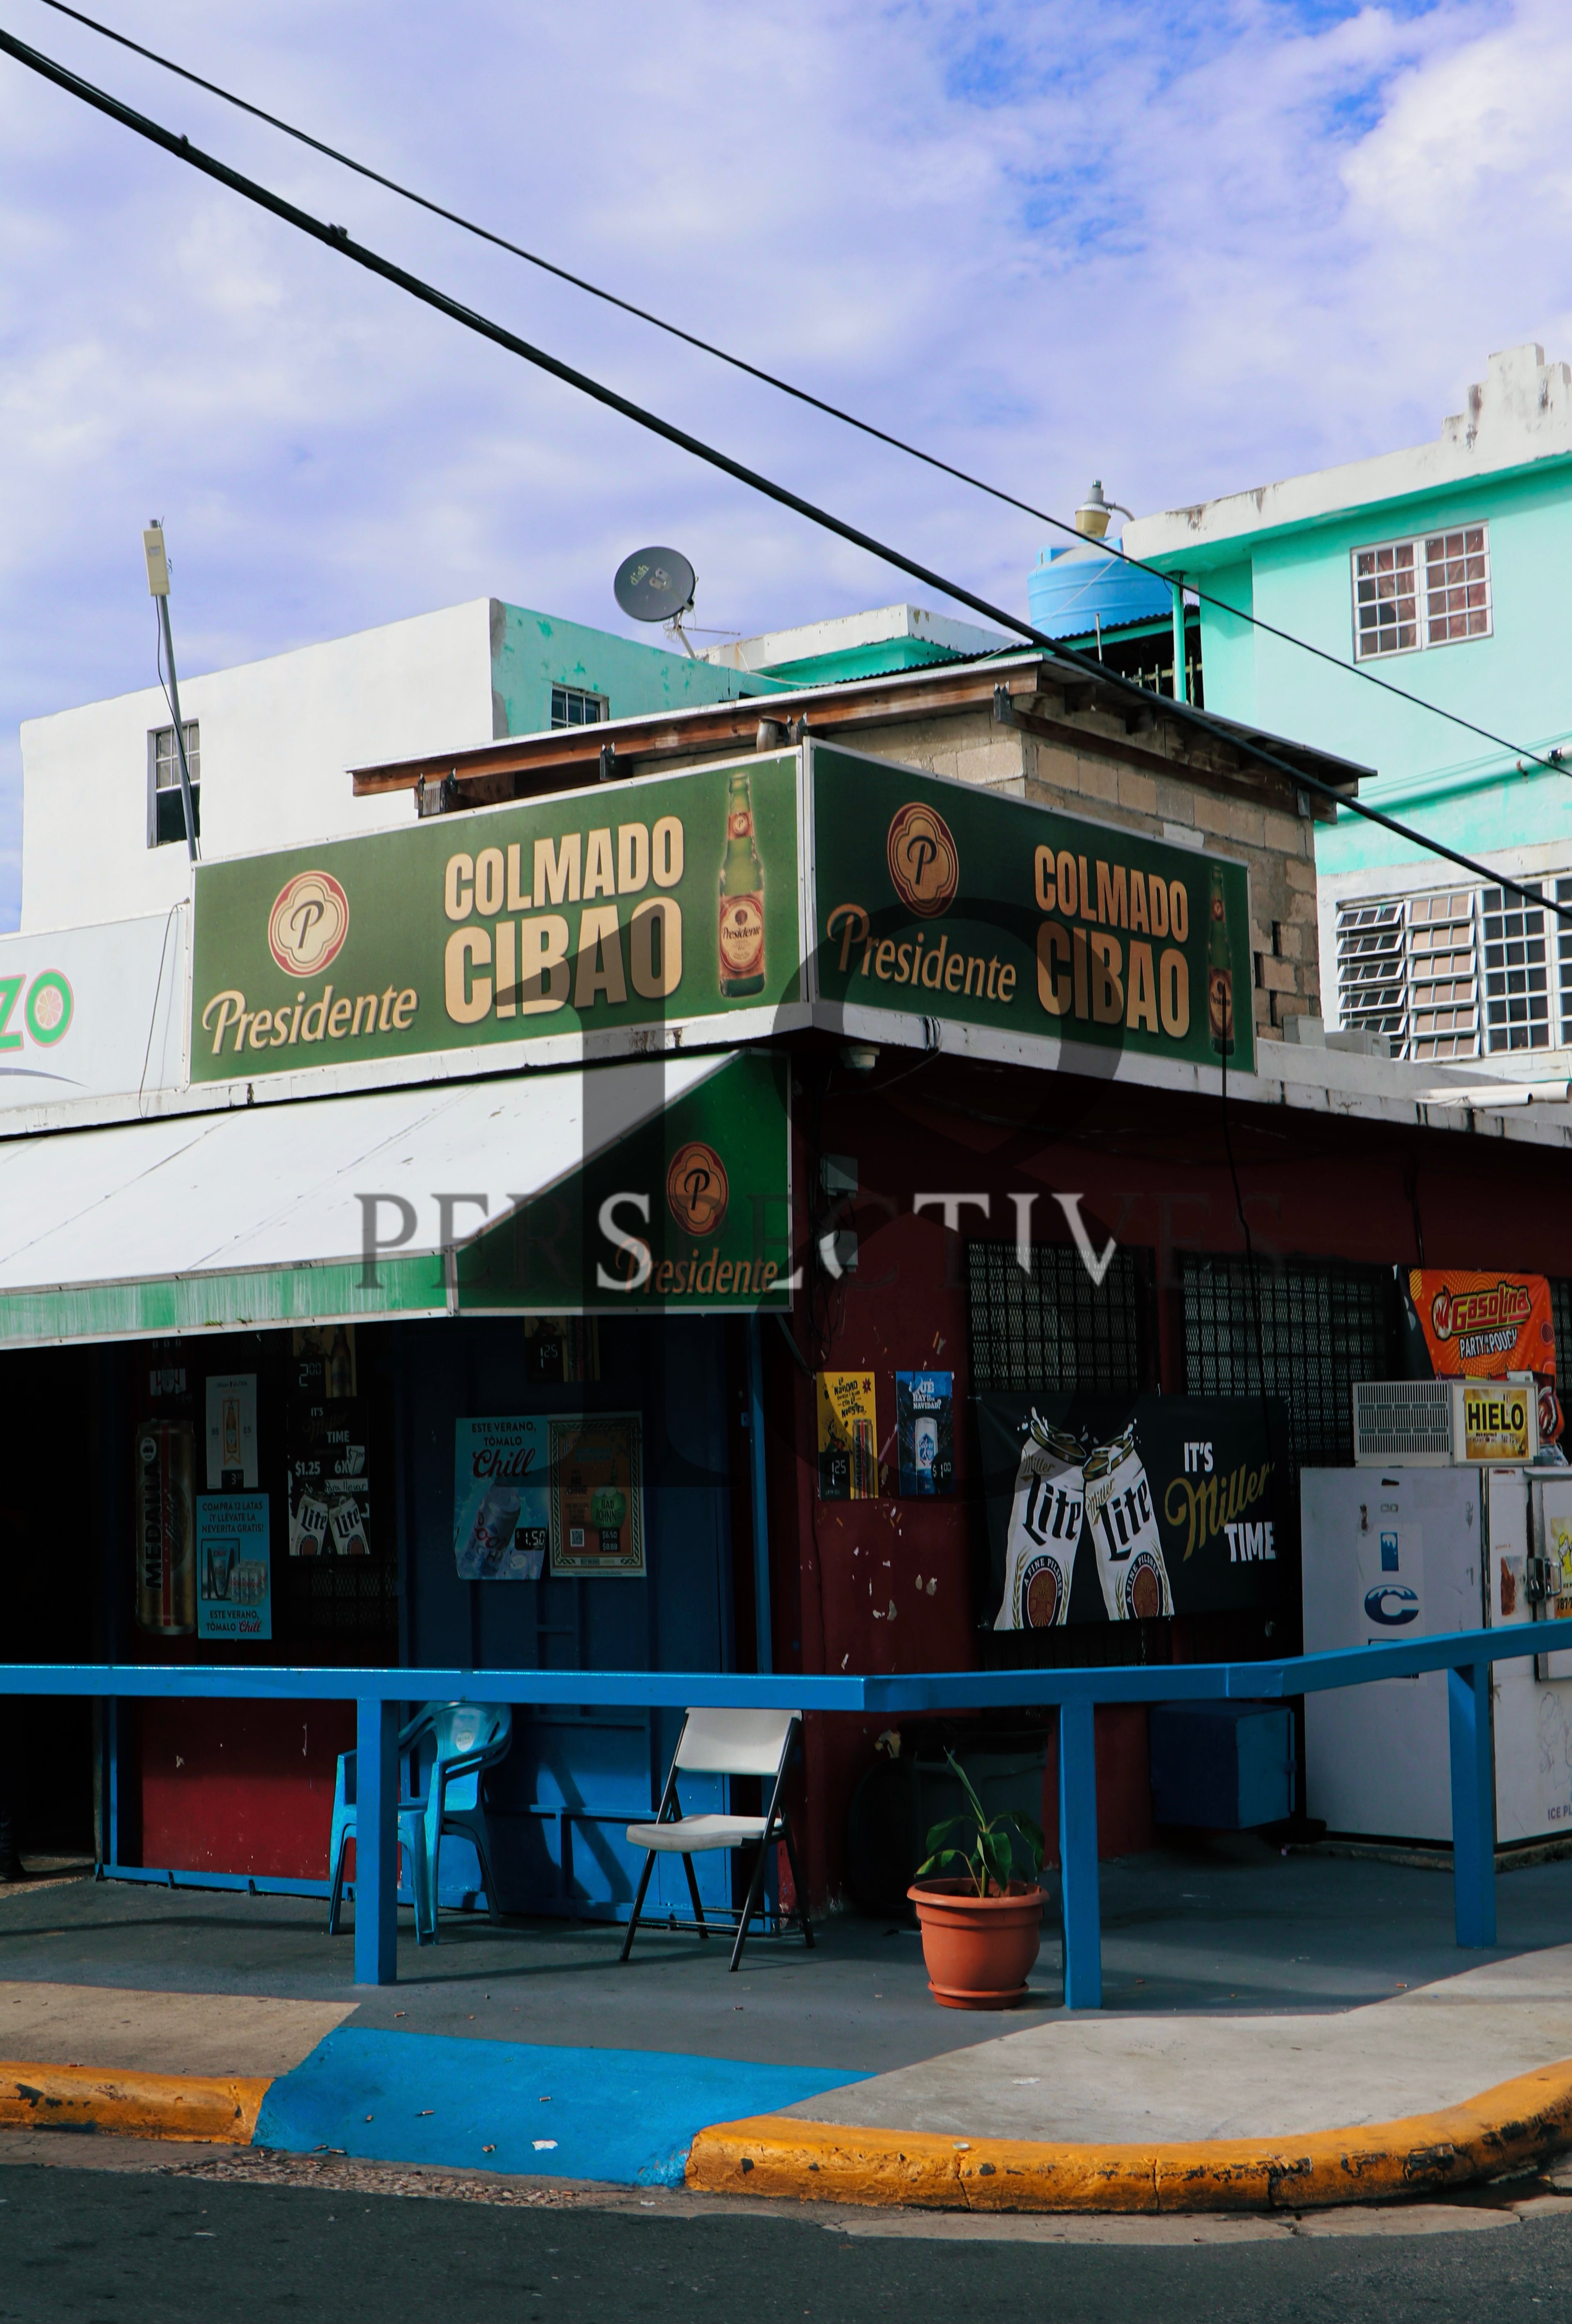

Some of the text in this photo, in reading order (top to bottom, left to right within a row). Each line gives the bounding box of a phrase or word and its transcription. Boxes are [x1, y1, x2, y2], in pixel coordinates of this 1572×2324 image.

[445, 817, 684, 921] COLMADO
[1034, 844, 1189, 943] COLMADO
[723, 924, 761, 940] Presidente
[445, 897, 684, 1025] CIBAO
[827, 902, 1017, 1004] Presidente
[1036, 921, 1190, 1039] CIBAO
[202, 983, 419, 1056] Presidente
[615, 1236, 779, 1295] Presidente
[1460, 1335, 1484, 1359] PARTY
[1490, 1328, 1518, 1353] POUCH
[310, 1407, 324, 1417] IT'S
[913, 1398, 942, 1410] NAVIDAD?
[1468, 1403, 1524, 1430] HIELO
[326, 1430, 350, 1444] TIME
[472, 1421, 536, 1433] ESTE VERANO,
[484, 1435, 522, 1446] TÓMALO
[295, 1460, 321, 1477] $1.25
[472, 1448, 535, 1478] Chill
[1021, 1446, 1056, 1476] Miller
[1184, 1441, 1213, 1473] IT'S
[202, 1502, 233, 1511] COMPRA
[242, 1501, 263, 1510] LATAS
[601, 1500, 614, 1509] BAD
[1022, 1468, 1082, 1546] Lite
[1085, 1476, 1116, 1517] Miller
[144, 1460, 163, 1589] MEDALLA
[247, 1513, 256, 1521] LA
[300, 1504, 327, 1532] Lite
[335, 1506, 360, 1538] Lite
[595, 1507, 623, 1522] JOHNNIE
[1099, 1478, 1152, 1562] Lite
[1164, 1462, 1276, 1562] Miller
[202, 1524, 264, 1534] NEVERITA GRATIS!
[1223, 1521, 1276, 1563] TIME
[1024, 1557, 1063, 1597] A FINE PILSNER
[1126, 1563, 1138, 1593] FINE
[1138, 1554, 1160, 1578] PILSNER
[206, 1620, 262, 1633] TÓMALO Chill
[210, 1610, 259, 1619] ESTE VERANO,
[1547, 1806, 1561, 1821] ICE
